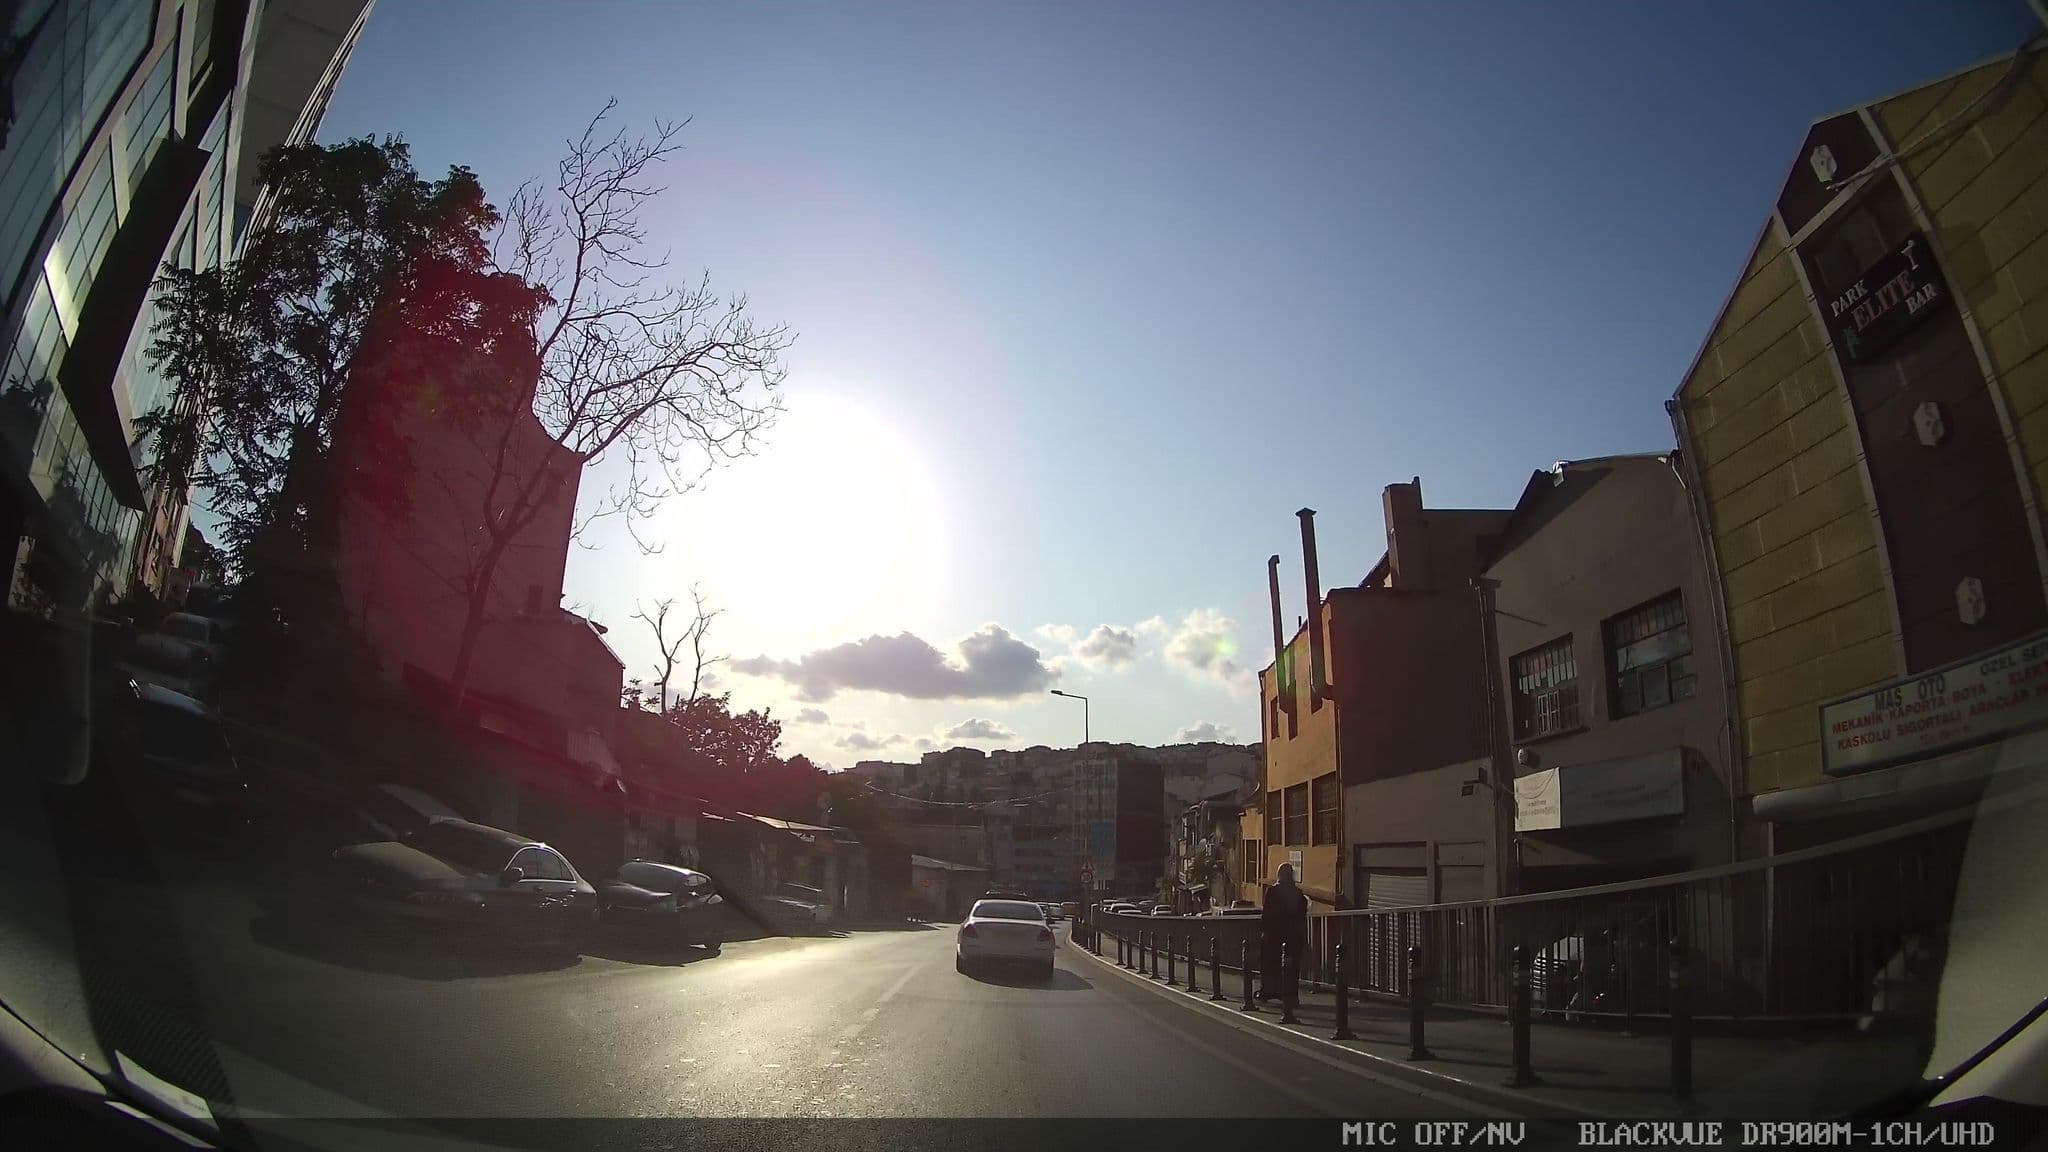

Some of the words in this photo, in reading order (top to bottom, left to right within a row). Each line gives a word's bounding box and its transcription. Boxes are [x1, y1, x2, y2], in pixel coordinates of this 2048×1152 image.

[1830, 280, 1868, 317] PARK
[1852, 270, 1915, 332] ELITE
[1905, 283, 1938, 314] BAR
[1875, 687, 1902, 711] MAS
[1918, 673, 1945, 700] OTO
[1889, 695, 1946, 720] KAPORTA
[1838, 728, 1890, 750] KASKOLU
